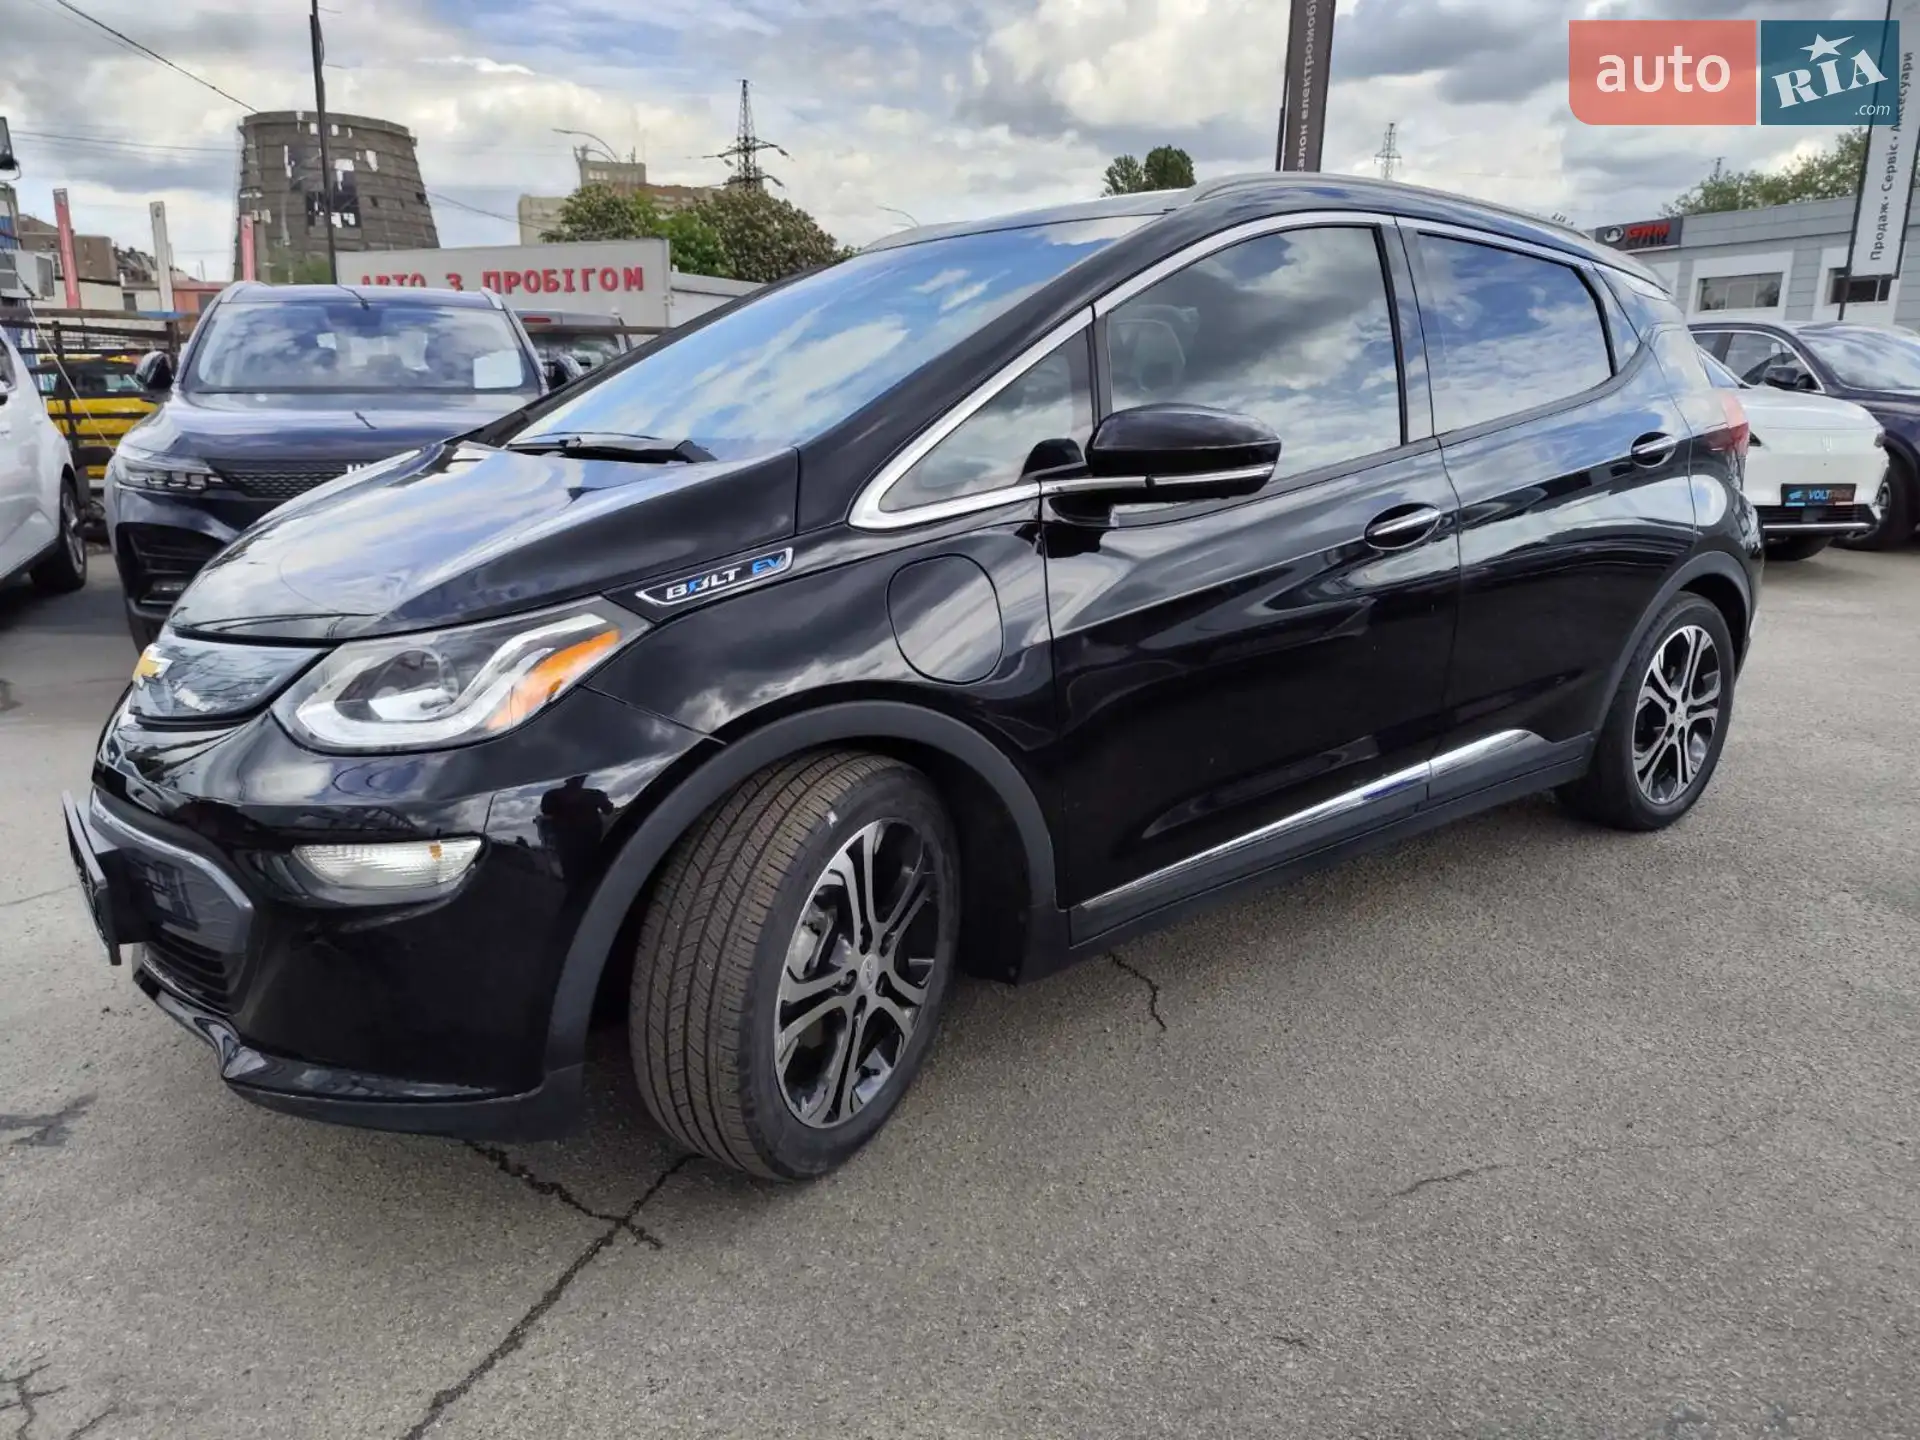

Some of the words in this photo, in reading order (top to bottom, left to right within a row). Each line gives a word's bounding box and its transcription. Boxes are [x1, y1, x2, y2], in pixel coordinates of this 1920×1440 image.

[1870, 202, 1889, 261] Продаж
[1881, 143, 1899, 192] Сервіс
[482, 266, 645, 295] ПРОБІГОМ
[666, 567, 741, 600] BOLT
[752, 555, 785, 576] EV
